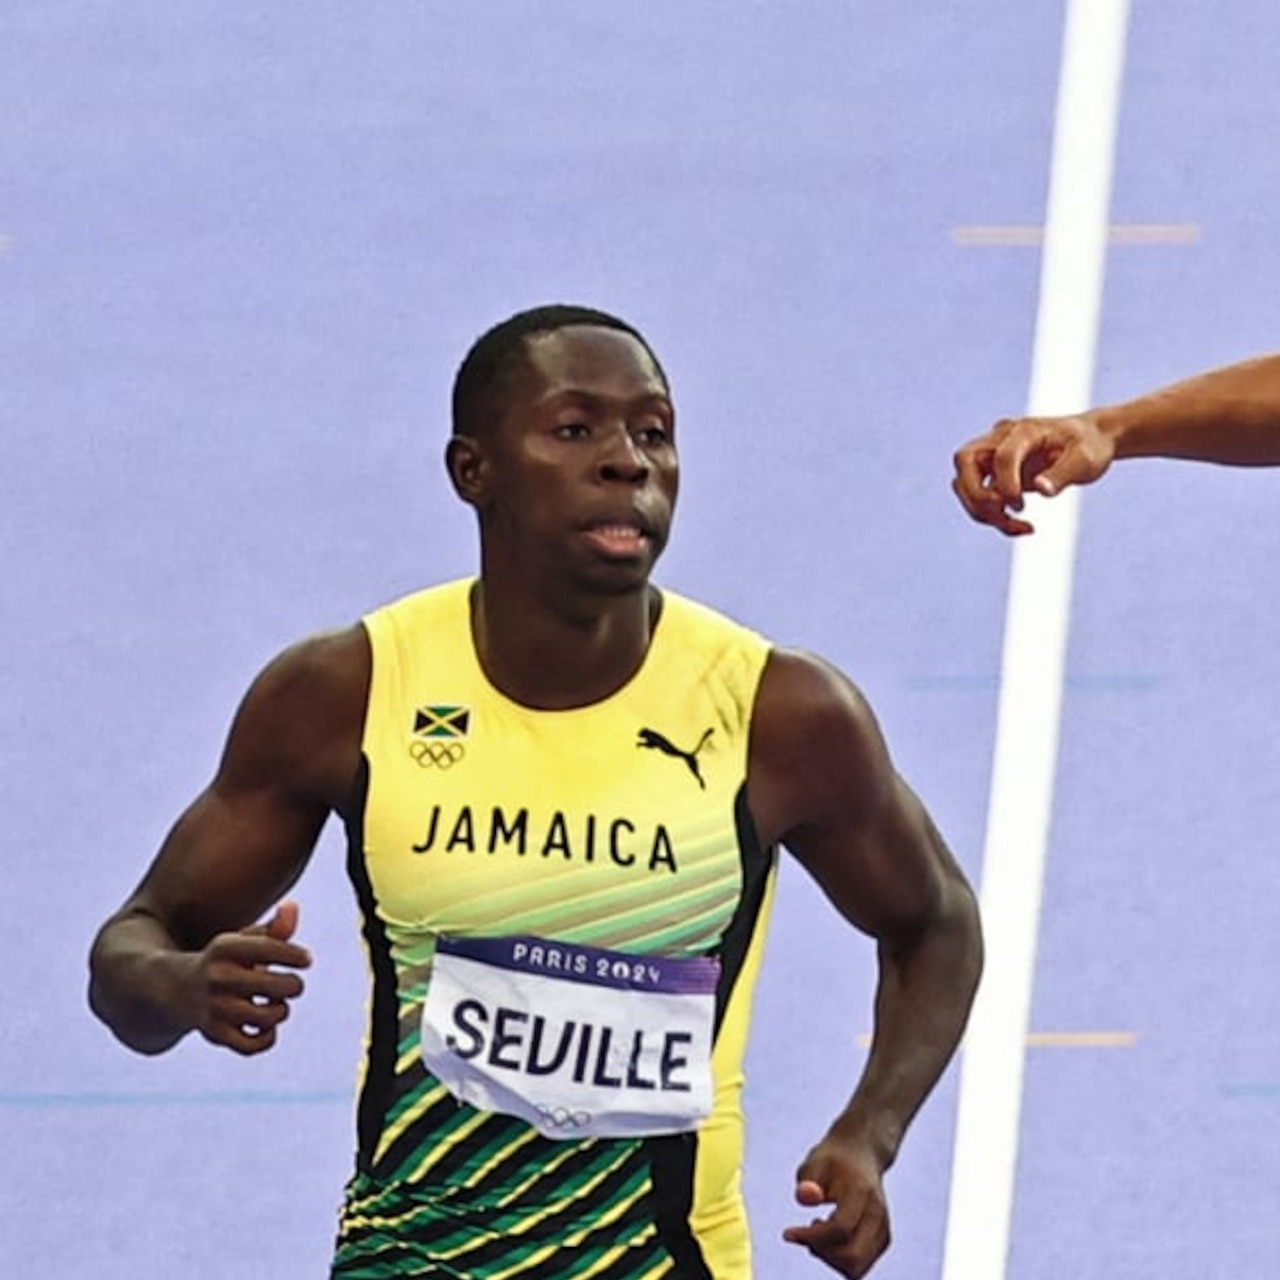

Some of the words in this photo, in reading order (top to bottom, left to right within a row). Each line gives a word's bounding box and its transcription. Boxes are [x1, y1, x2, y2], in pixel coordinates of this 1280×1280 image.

[411, 804, 677, 873] JAMAICA
[513, 943, 588, 974] PARIS
[596, 959, 660, 984] 2024
[446, 1000, 692, 1092] SEVILLE
